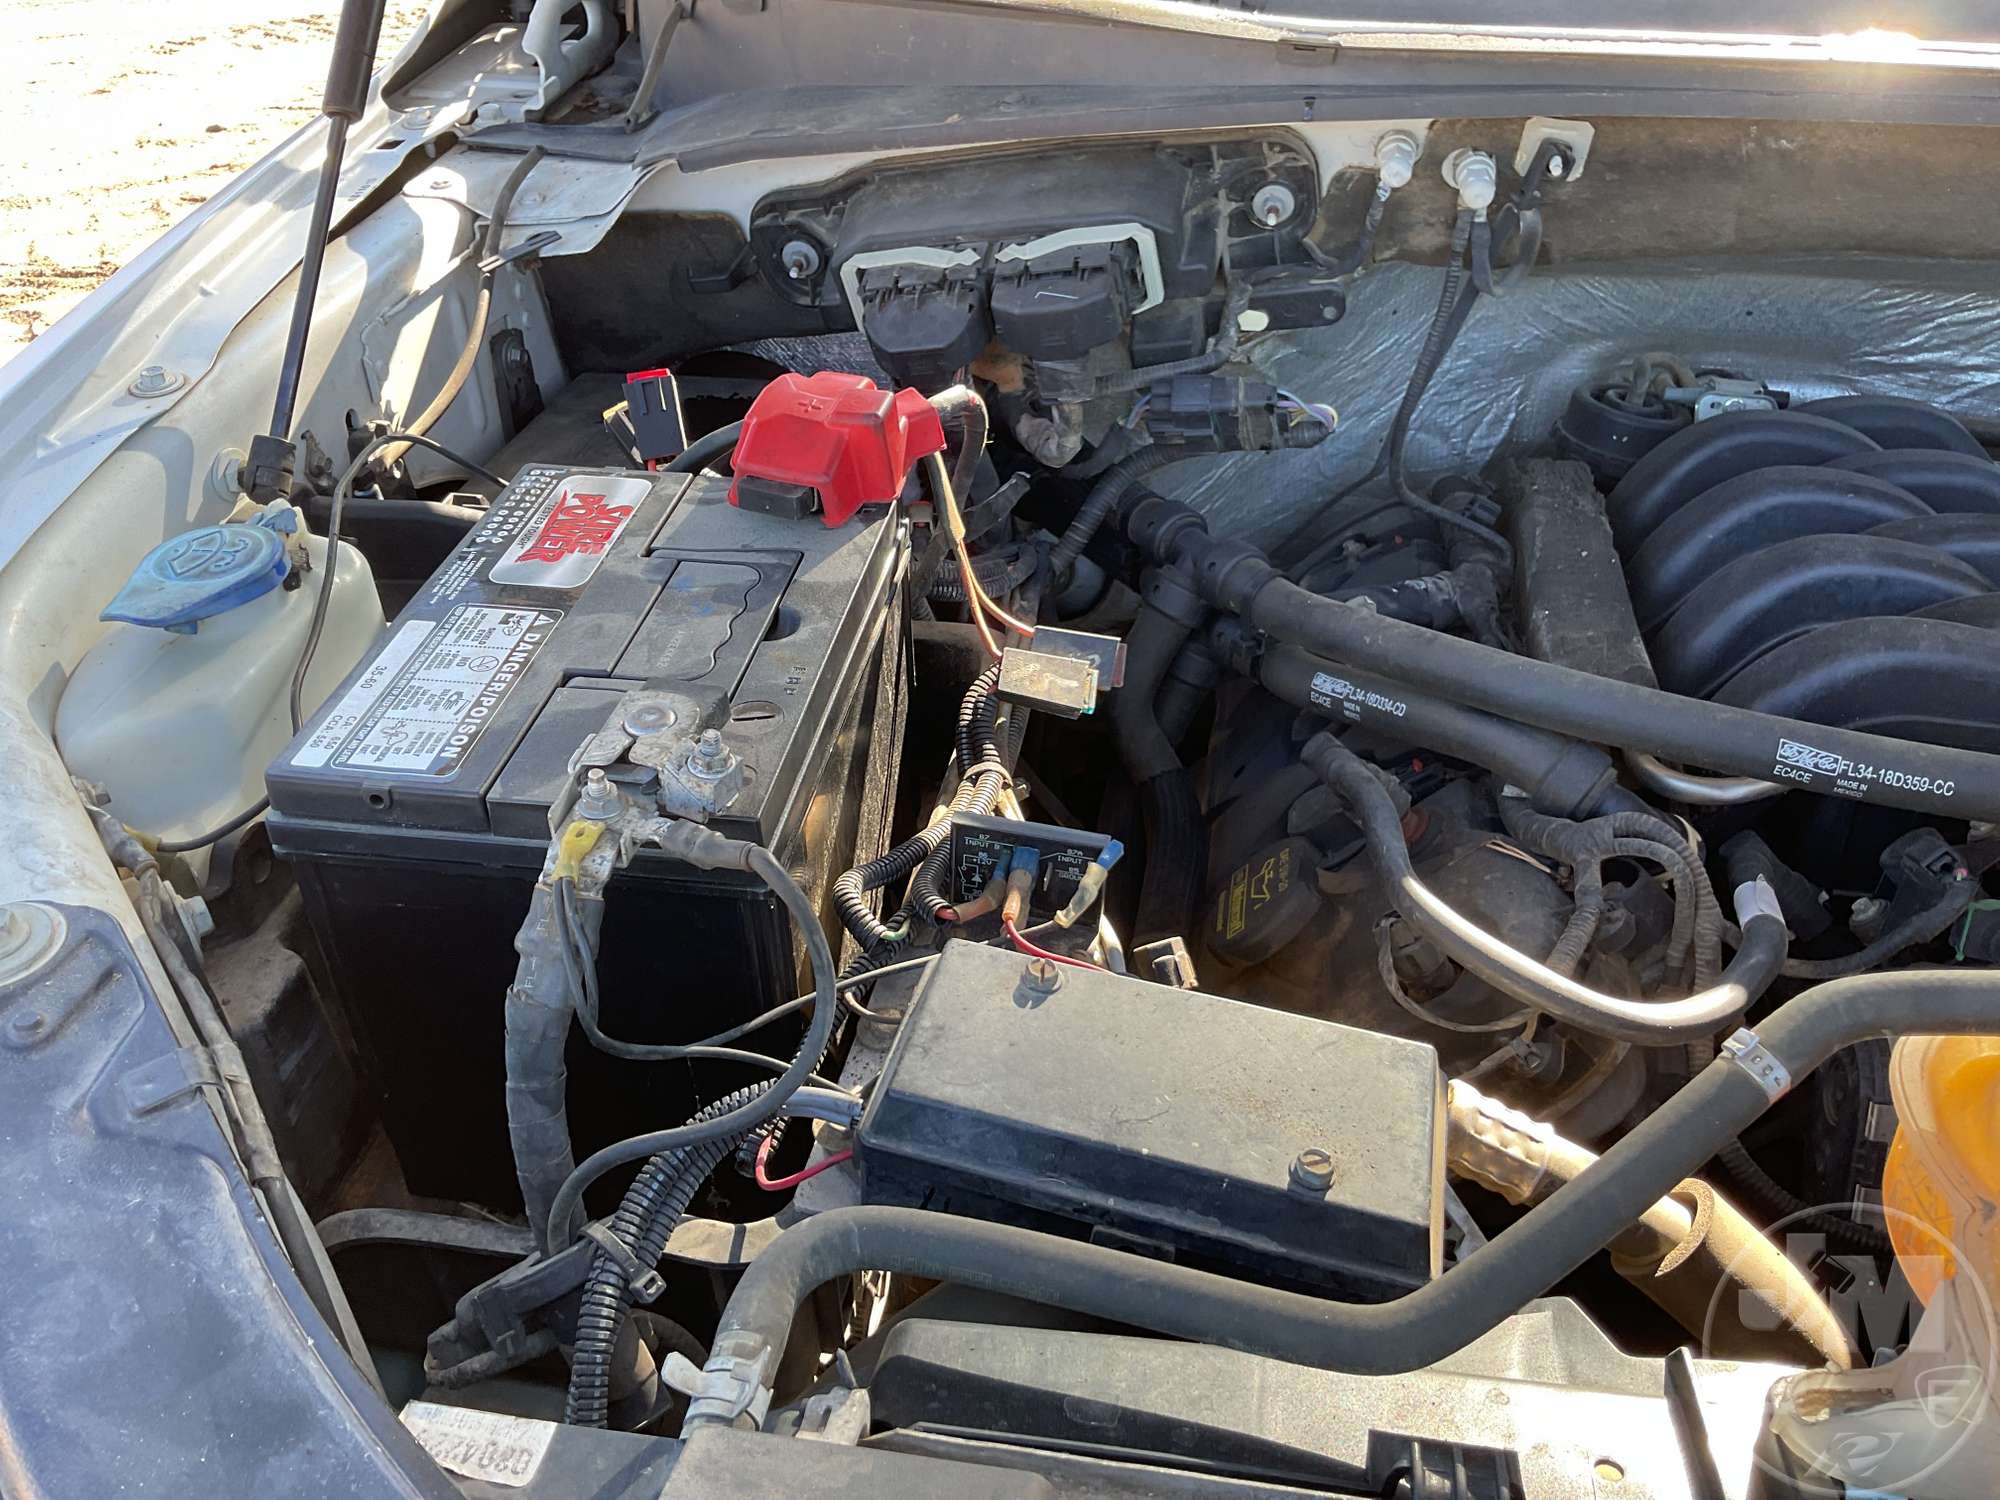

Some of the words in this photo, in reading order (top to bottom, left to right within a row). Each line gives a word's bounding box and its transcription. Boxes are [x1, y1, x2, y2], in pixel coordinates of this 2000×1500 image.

[514, 493, 607, 563] POWER
[566, 505, 634, 556] SURE
[454, 657, 471, 666] NO
[358, 665, 388, 688] 35-60
[440, 633, 541, 758] DANGER/POISON
[319, 715, 343, 733] CCA:
[1773, 764, 1813, 784] EC4CE
[1836, 778, 1859, 789] MADE
[1859, 783, 1868, 792] IN
[1838, 760, 1955, 797] FL34-18D359-CC
[1833, 787, 1864, 798] MEXICO
[964, 838, 989, 848] INPUT
[1057, 855, 1082, 865] INPUT
